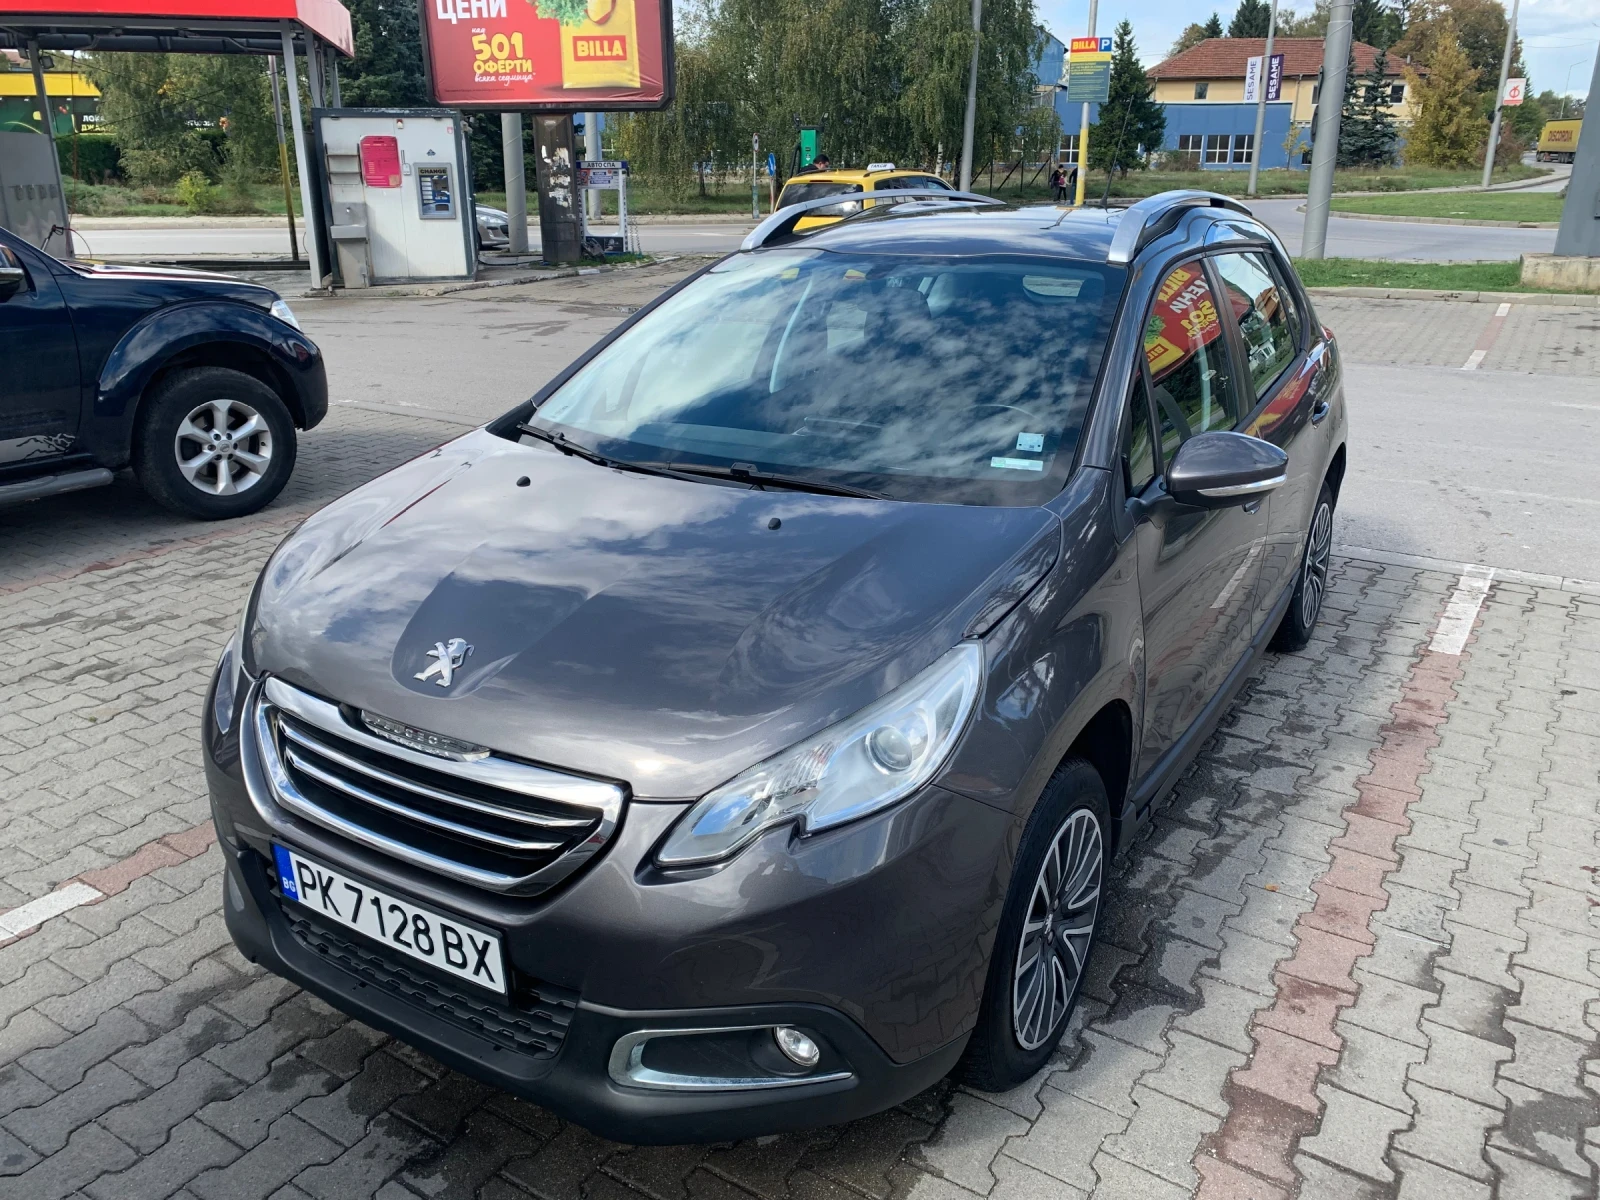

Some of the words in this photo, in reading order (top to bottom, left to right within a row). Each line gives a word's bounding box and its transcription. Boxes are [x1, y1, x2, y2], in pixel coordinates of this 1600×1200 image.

[436, 0, 507, 24] ЦЕНИ
[472, 31, 524, 60] 501
[576, 39, 624, 57] BILLA
[1072, 40, 1097, 50] BILLA
[1101, 39, 1110, 50] P
[473, 59, 533, 74] ОФЕРТИ
[475, 73, 497, 82] всяка
[1246, 60, 1257, 101] SESAME
[1268, 56, 1280, 99] SESAME
[282, 876, 297, 893] BG
